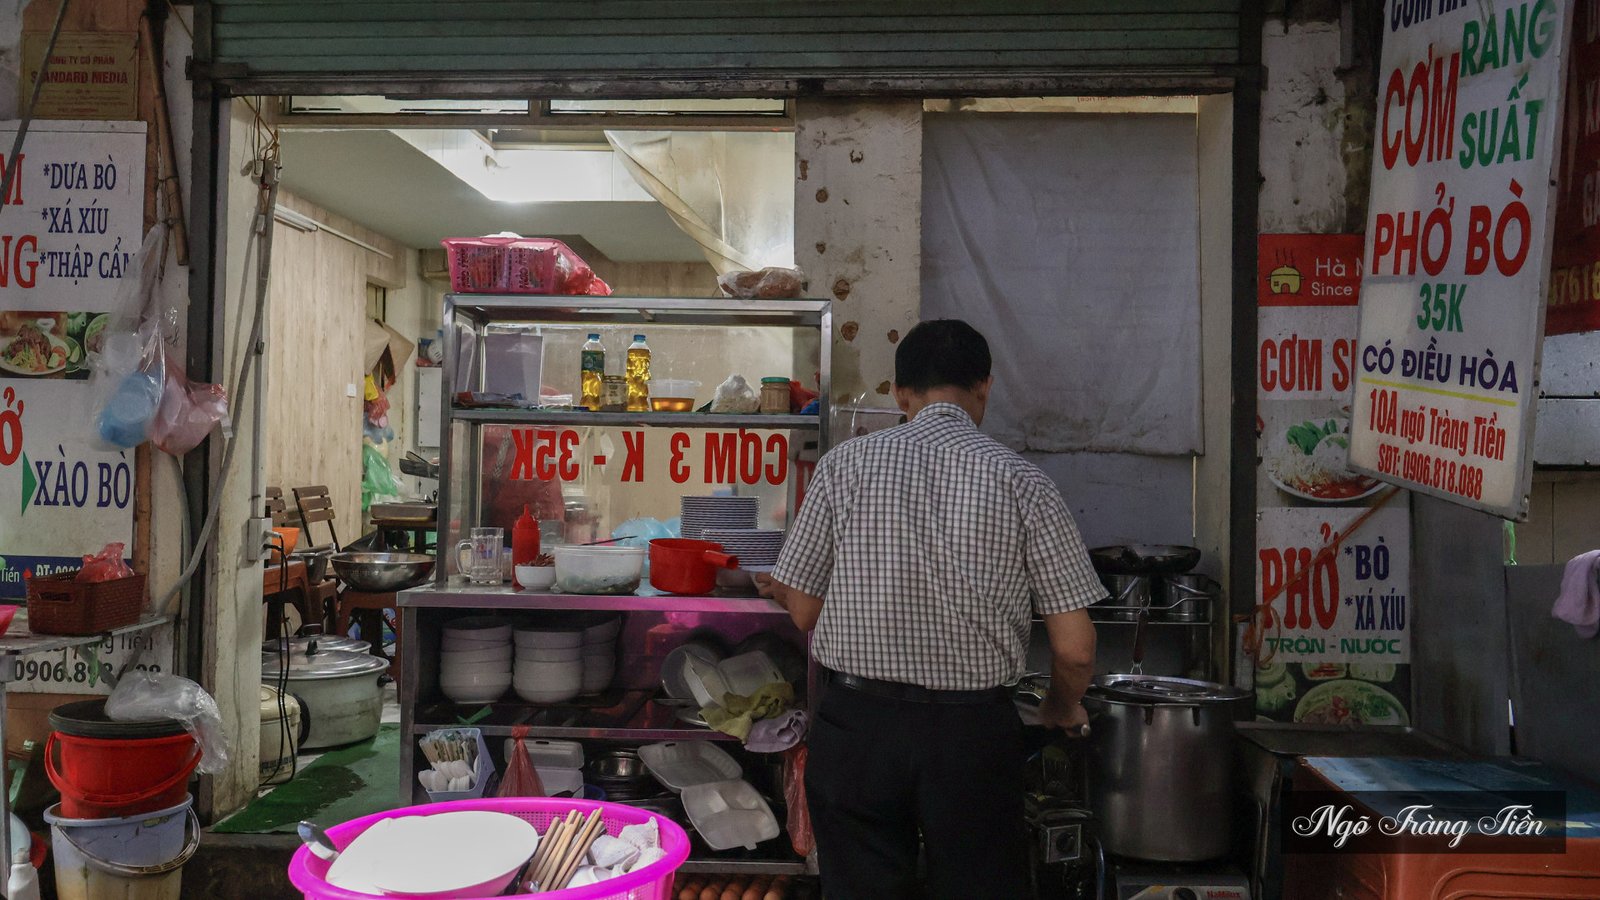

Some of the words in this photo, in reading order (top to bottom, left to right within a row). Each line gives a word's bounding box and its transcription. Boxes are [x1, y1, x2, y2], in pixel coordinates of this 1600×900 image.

[1460, 0, 1556, 78] RANG
[31, 71, 89, 84] SANDARD
[92, 71, 128, 84] MEDIA
[1382, 43, 1460, 170] CƠM
[1459, 72, 1546, 170] SUẤT
[93, 154, 117, 190] BÒ
[78, 198, 109, 234] XÍU
[1372, 182, 1455, 276] PHỞ
[1464, 178, 1532, 277] BÒ
[1312, 281, 1353, 296] Since
[1315, 257, 1346, 277] Hà
[1417, 282, 1467, 332] 35K
[1260, 334, 1323, 392] CƠM
[1362, 339, 1395, 375] CÓ
[1401, 336, 1452, 383] ĐIỀU
[1459, 348, 1519, 393] HÒA
[1370, 388, 1398, 436] 10A
[1429, 408, 1469, 456] Tràng
[1473, 412, 1506, 460] Tiền
[33, 444, 89, 508] XÀO
[96, 451, 131, 509] BÒ
[1377, 443, 1400, 477] SĐT:
[1402, 450, 1483, 500] 0906.818.088
[1260, 522, 1339, 630] PHỞ
[1380, 587, 1406, 631] XÍU
